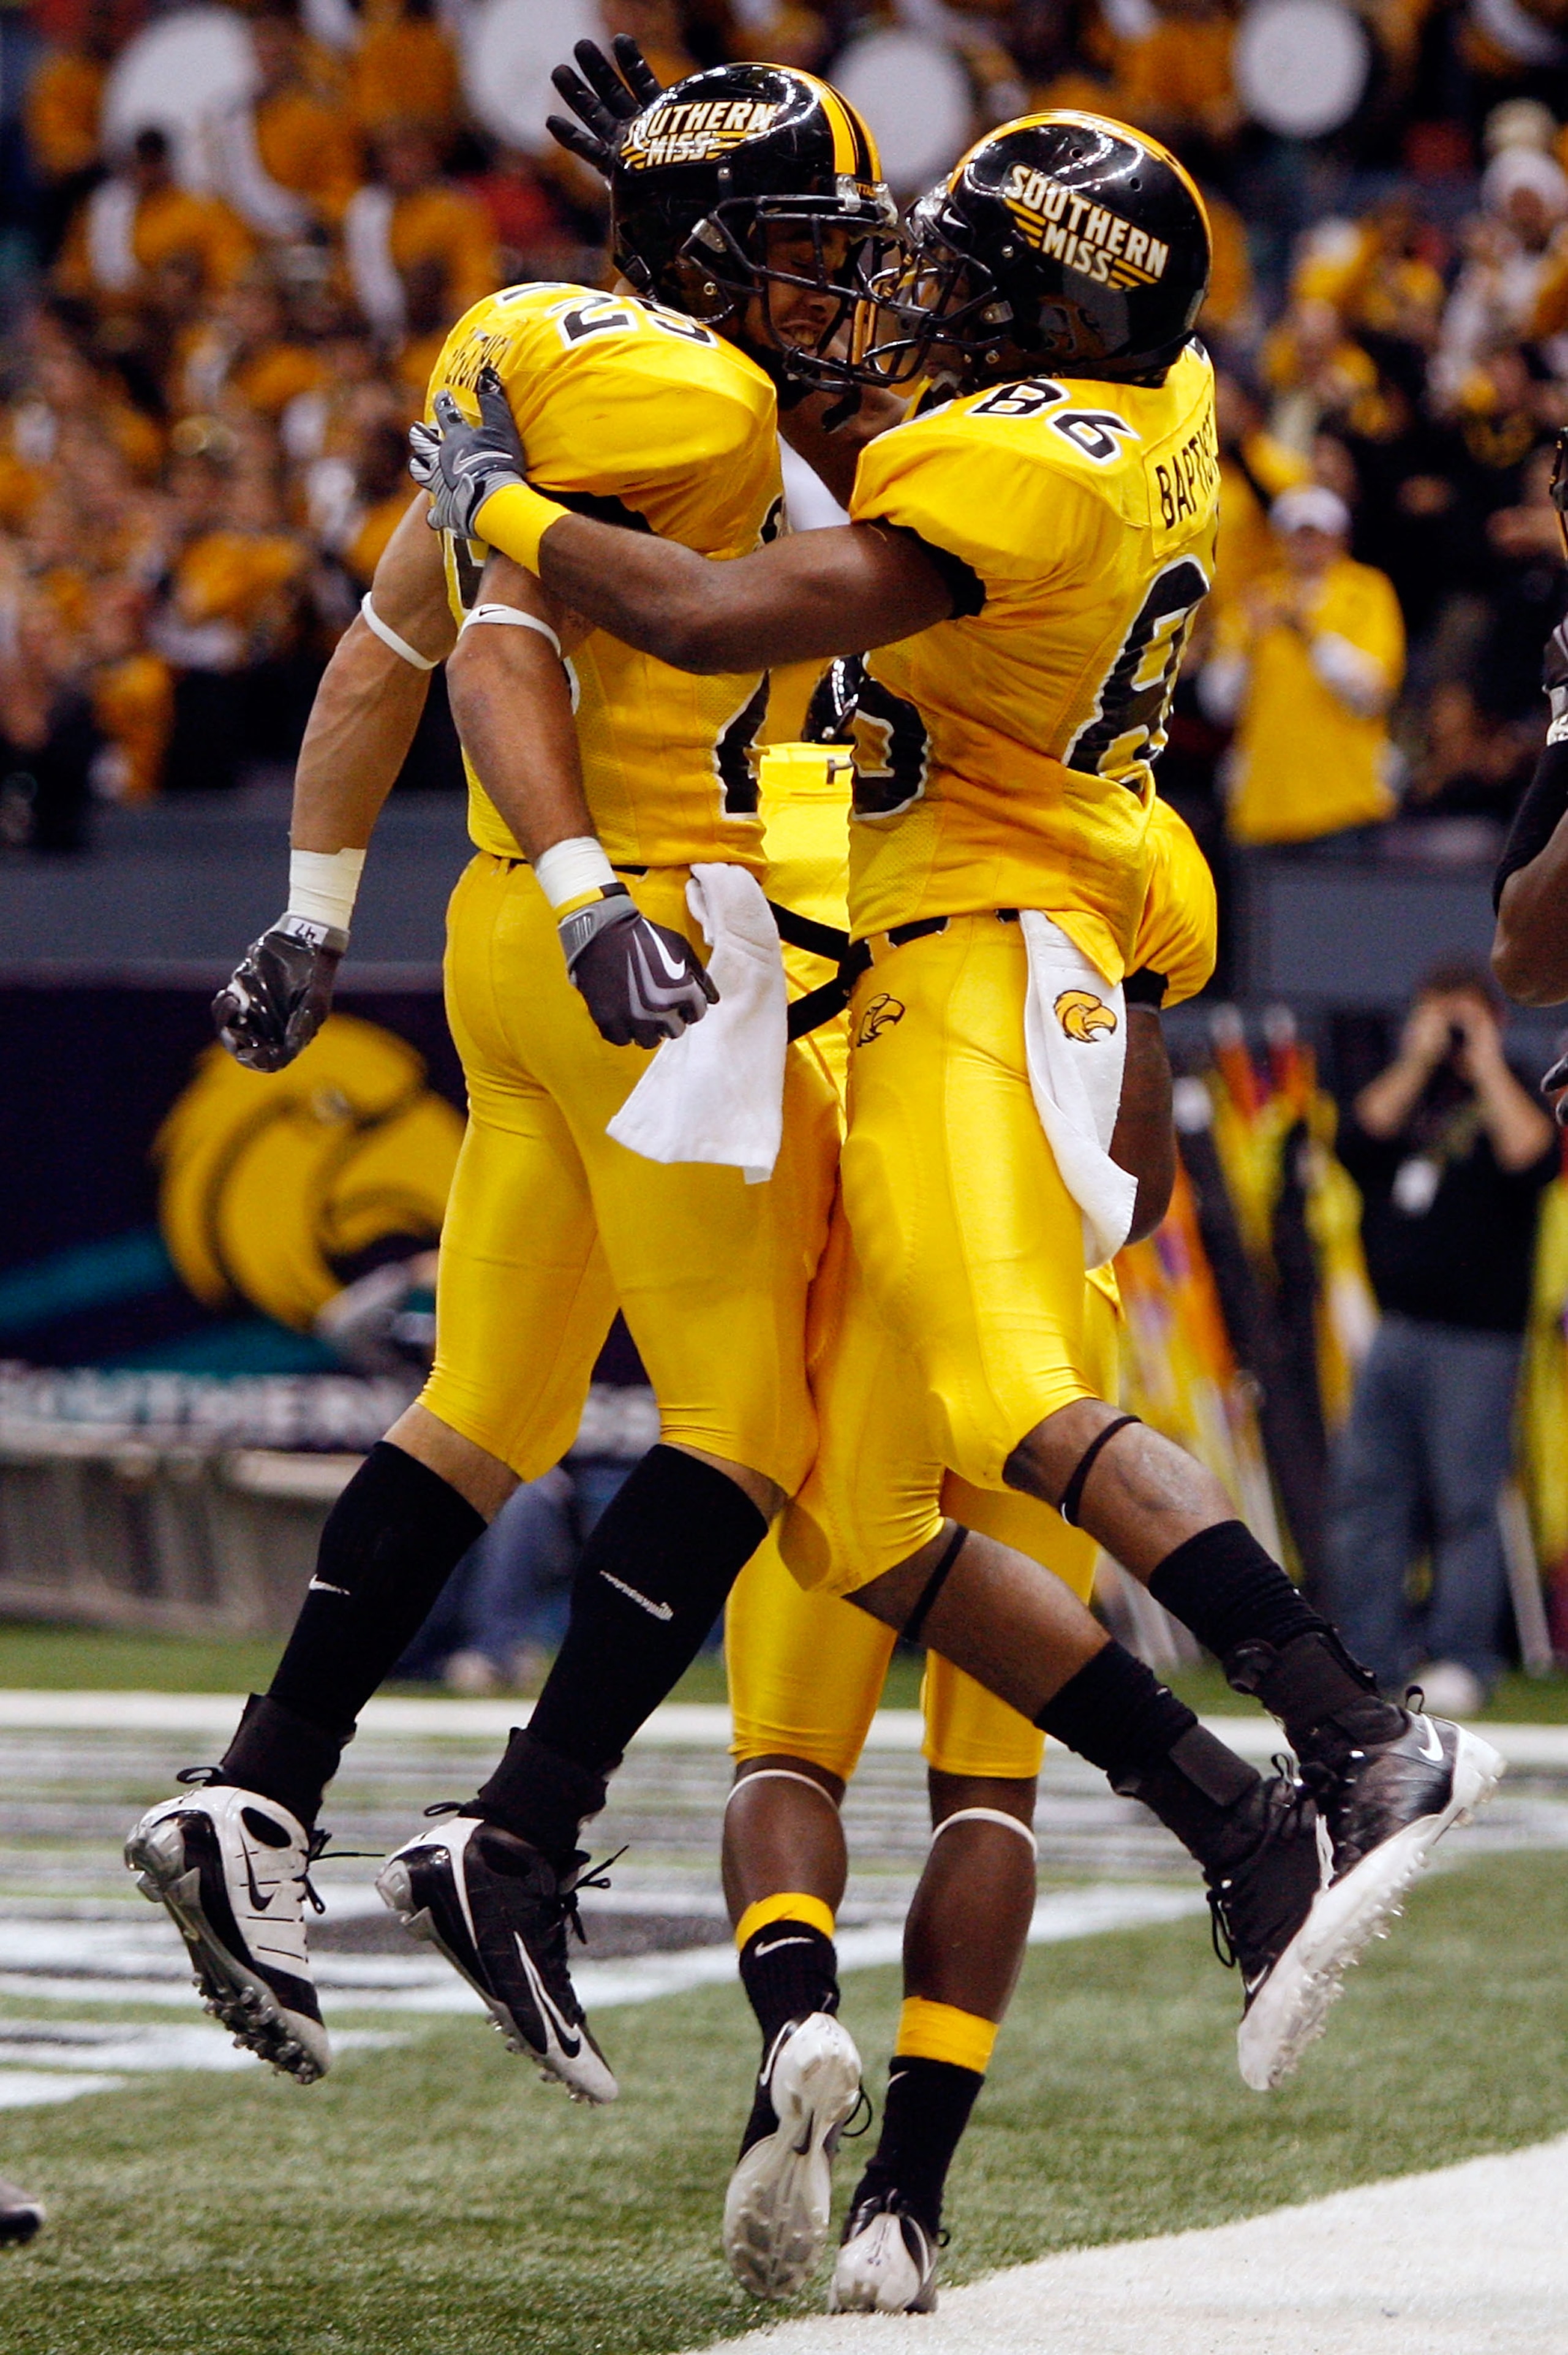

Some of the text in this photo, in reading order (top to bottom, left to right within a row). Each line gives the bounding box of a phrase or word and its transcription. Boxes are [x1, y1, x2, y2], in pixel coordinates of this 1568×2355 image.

[646, 130, 712, 167] MISS
[1004, 164, 1169, 278] SOUTHERN
[1042, 221, 1113, 282] MISS
[965, 378, 1141, 465] 86
